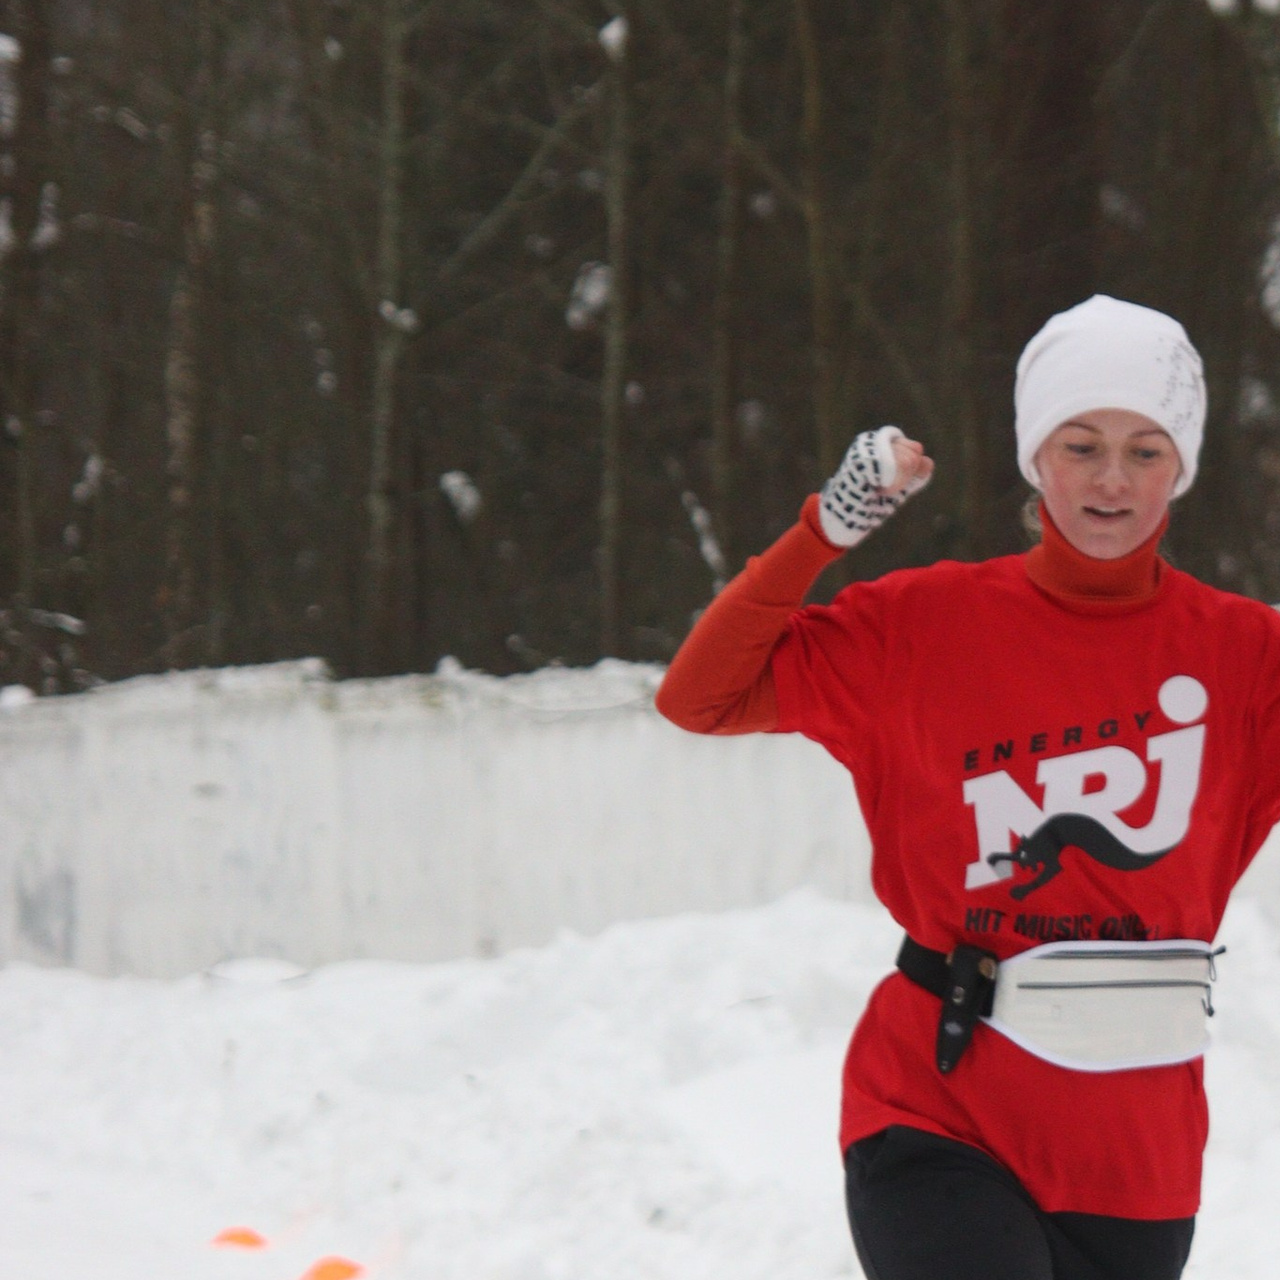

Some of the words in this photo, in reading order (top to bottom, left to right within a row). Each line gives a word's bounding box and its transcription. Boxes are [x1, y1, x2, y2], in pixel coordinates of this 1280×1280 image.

[963, 711, 1151, 770] ENERGY
[964, 907, 1006, 933] HIT
[1014, 913, 1092, 941] MUSIC
